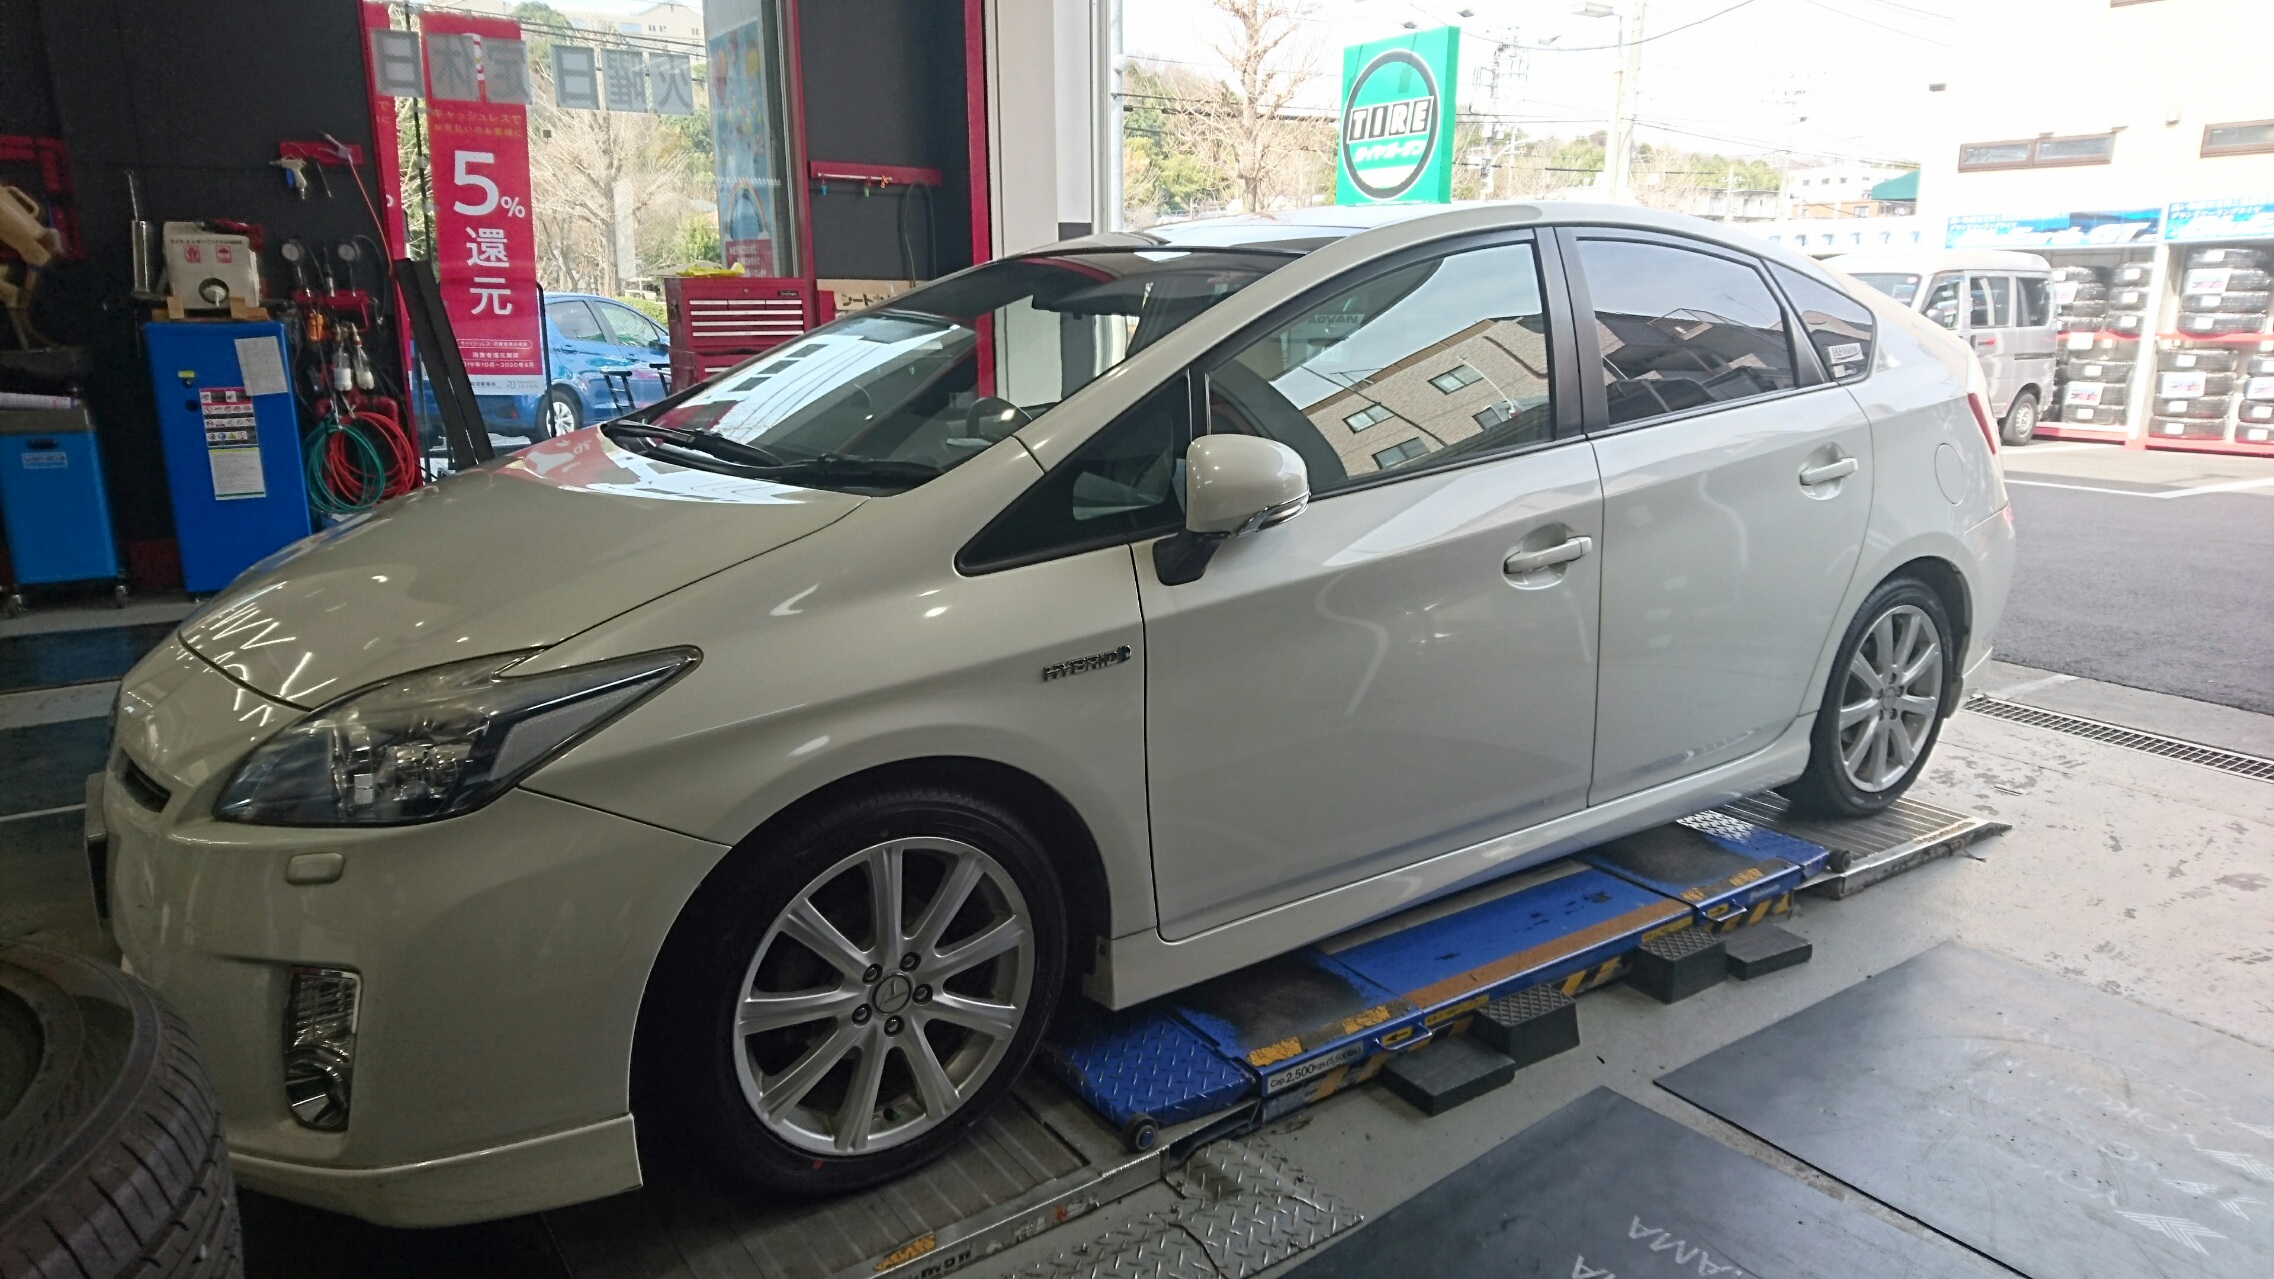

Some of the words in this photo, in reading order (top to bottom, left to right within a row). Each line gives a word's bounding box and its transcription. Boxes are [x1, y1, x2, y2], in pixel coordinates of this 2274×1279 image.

[1350, 99, 1431, 141] TIRE
[465, 226, 513, 315] 還元
[1042, 650, 1118, 682] HYBRID
